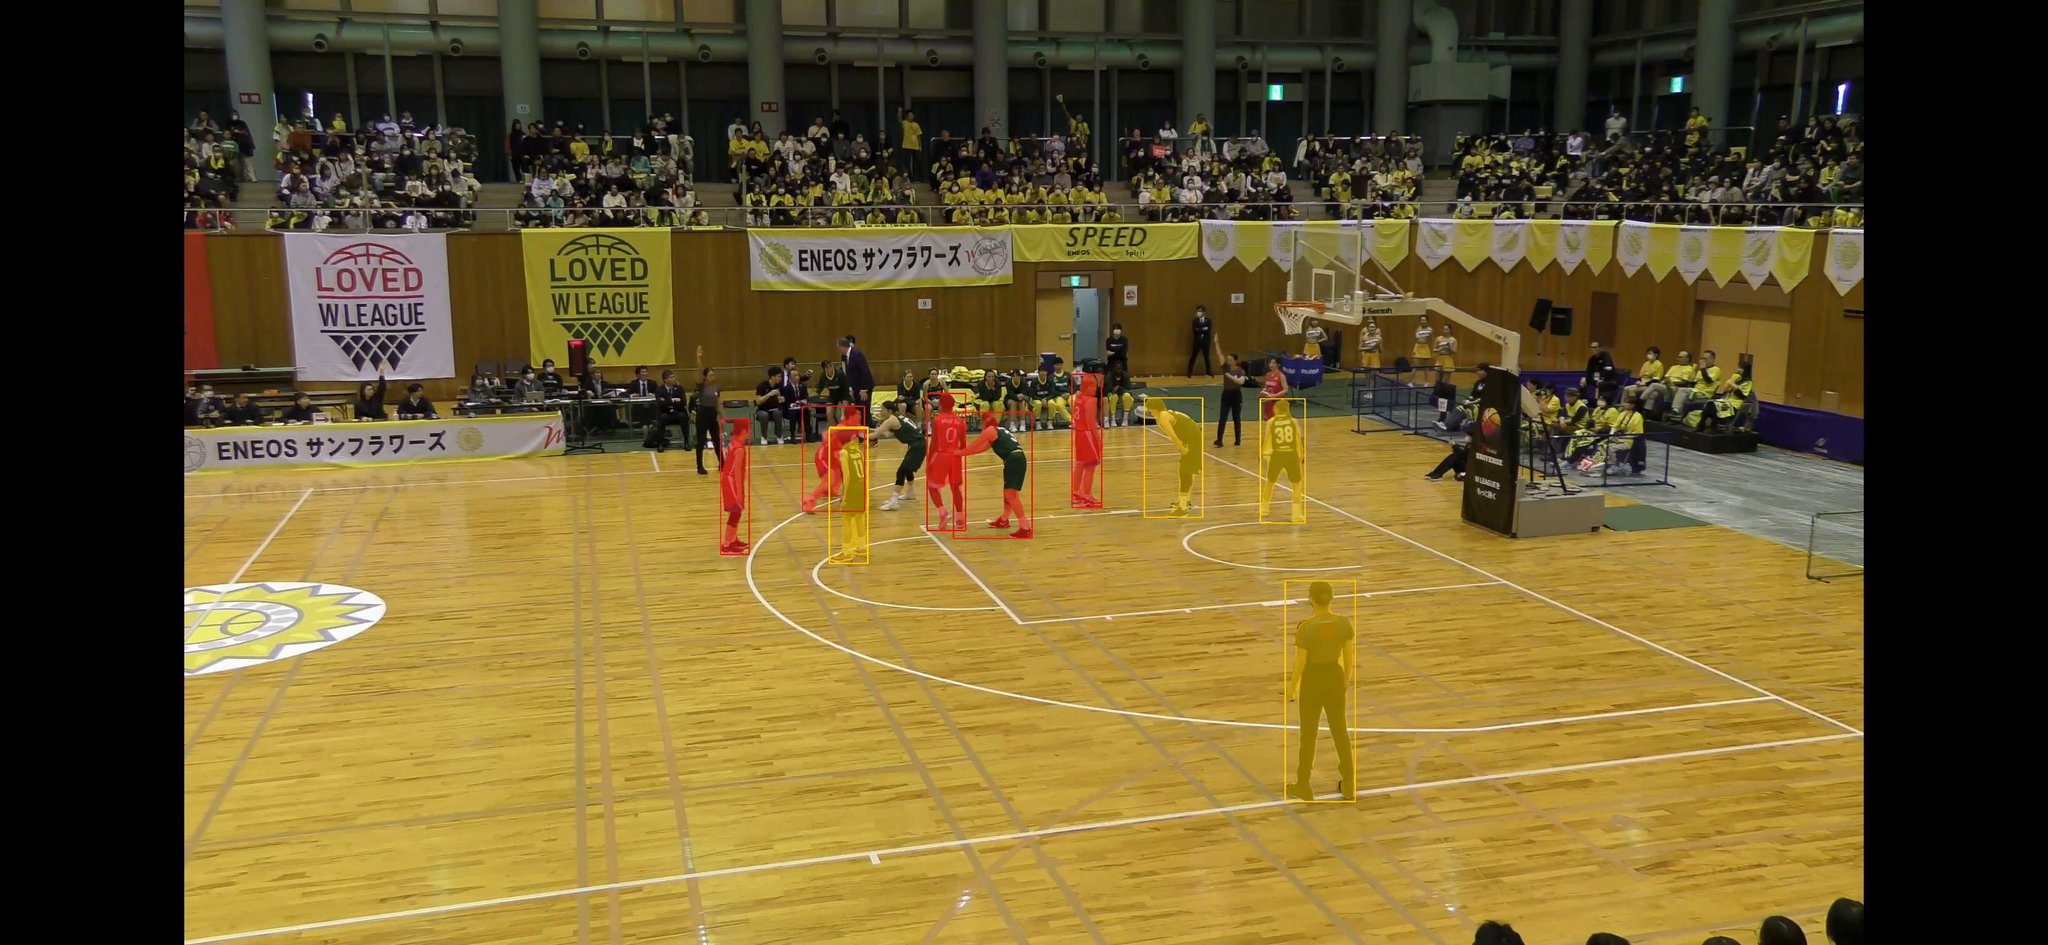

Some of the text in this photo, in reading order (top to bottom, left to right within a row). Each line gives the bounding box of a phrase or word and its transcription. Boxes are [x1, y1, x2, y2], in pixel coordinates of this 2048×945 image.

[1066, 226, 1148, 248] SPEED
[798, 248, 857, 272] ENEOS
[862, 242, 962, 270] サンフラワーズ
[1067, 249, 1145, 258] ENEOS Spirit
[315, 266, 424, 293] LOVED
[549, 257, 649, 282] LOVED
[318, 302, 425, 328] W LEAGUE
[551, 292, 649, 316] W LEAGUE
[1367, 307, 1392, 315] Senoh
[217, 438, 299, 461] ENEOS
[306, 430, 447, 458] サンフラワーズ
[1275, 425, 1294, 444] 38
